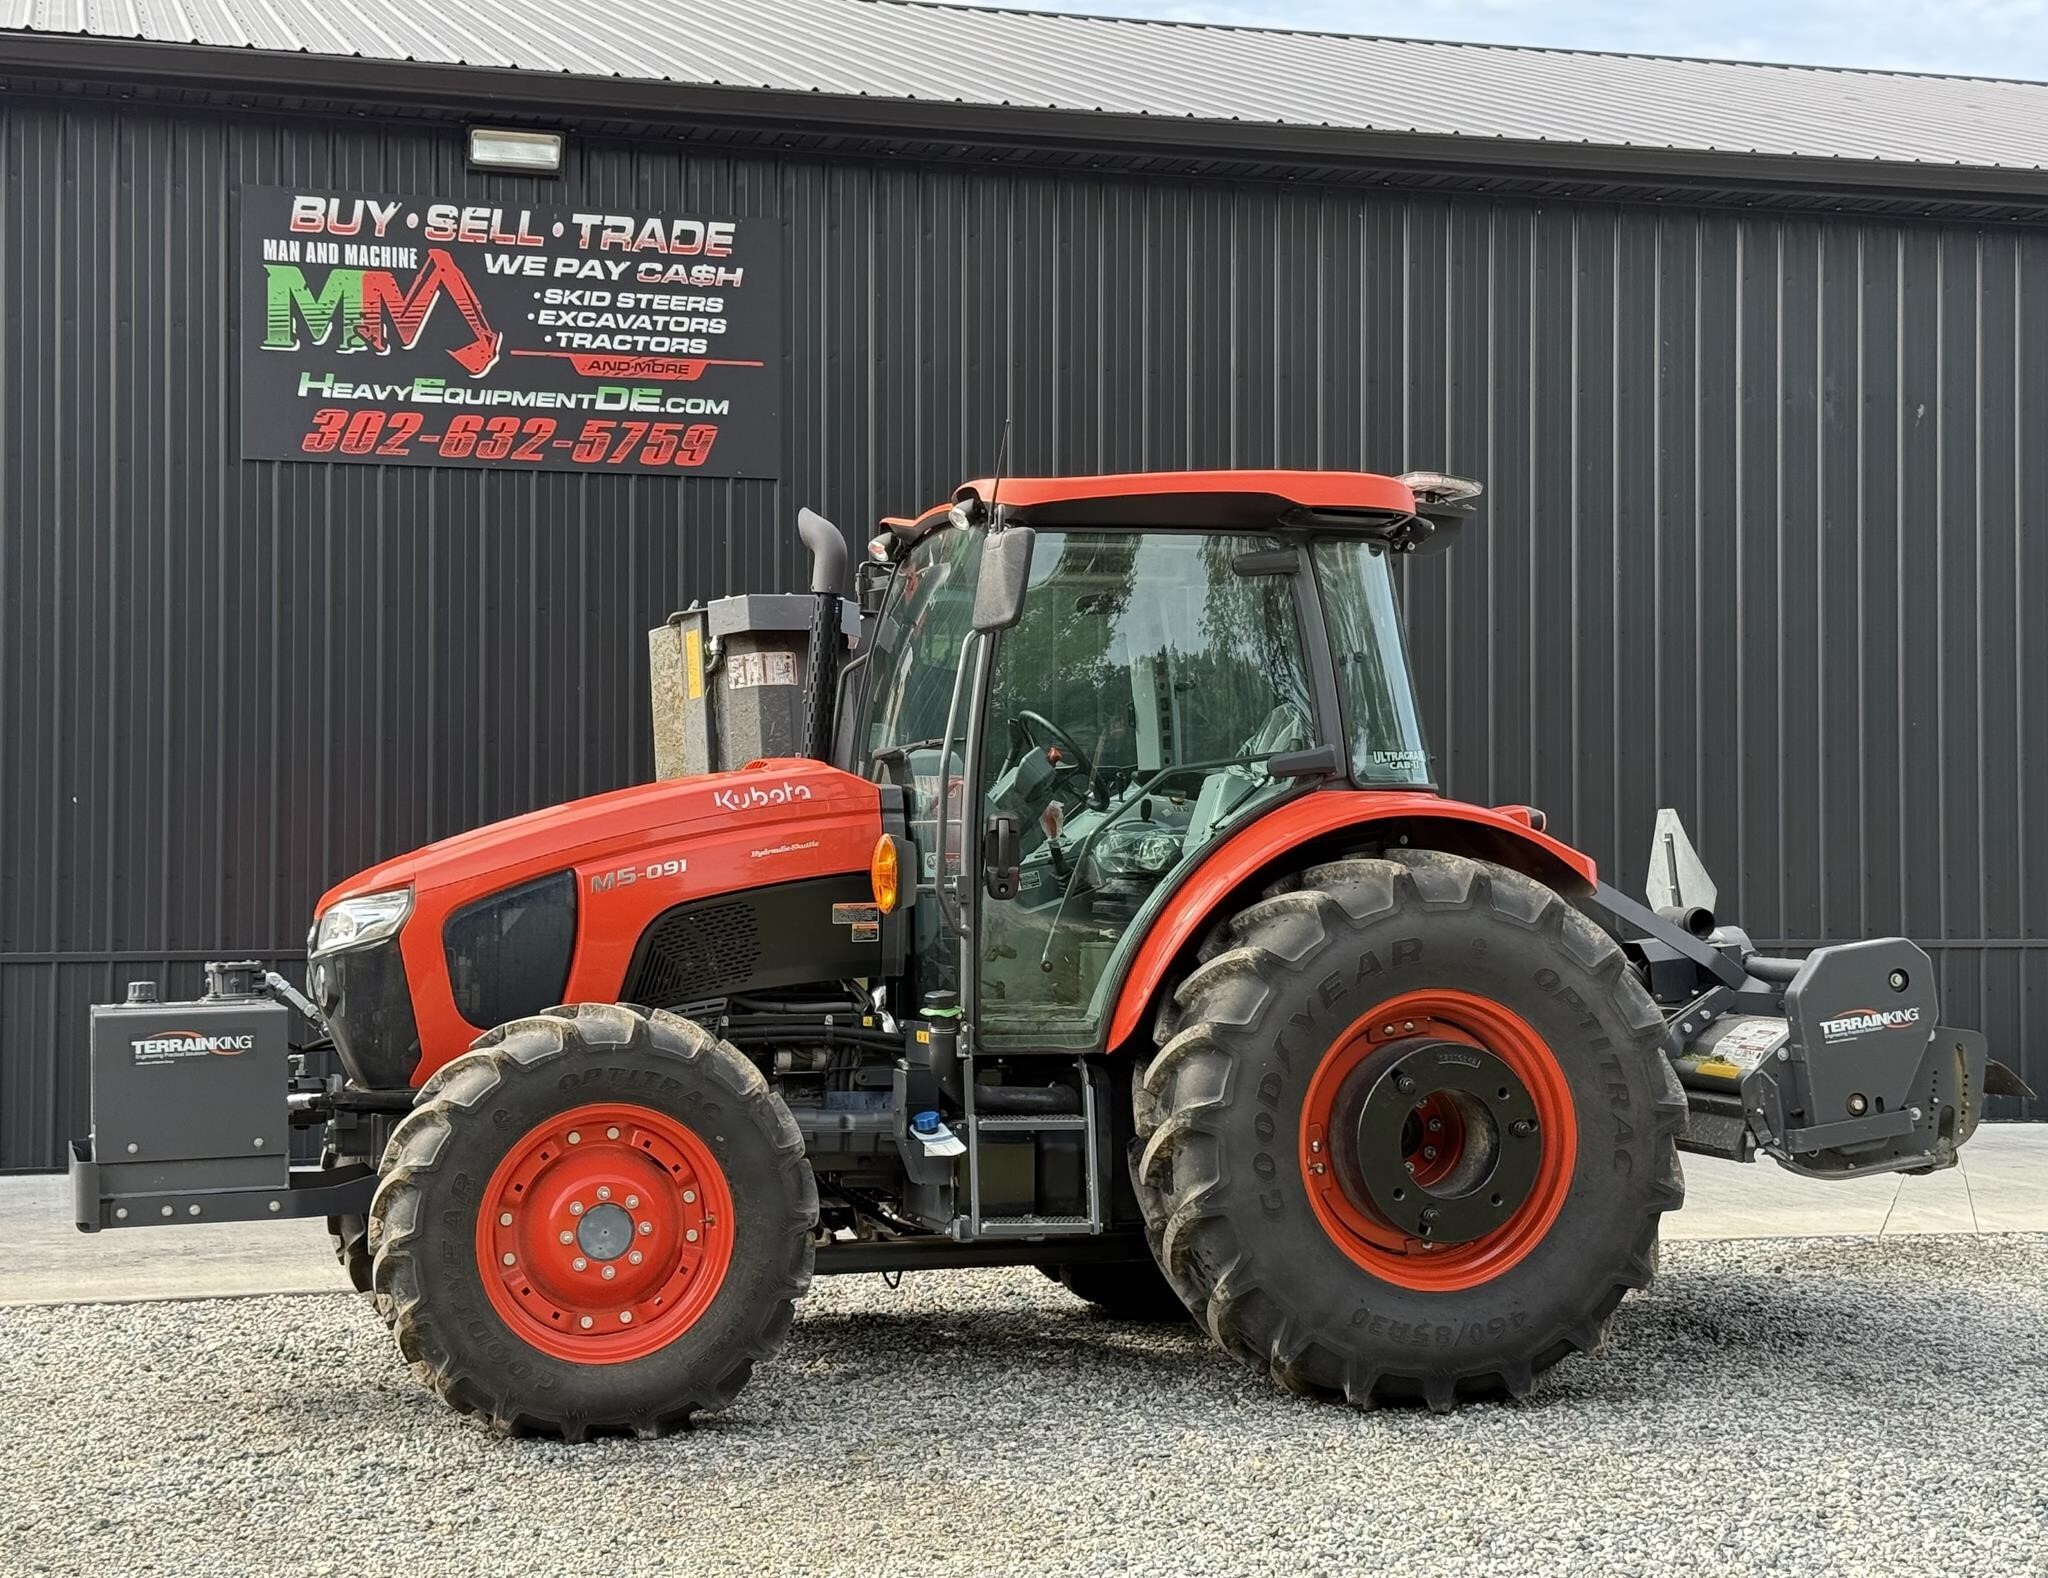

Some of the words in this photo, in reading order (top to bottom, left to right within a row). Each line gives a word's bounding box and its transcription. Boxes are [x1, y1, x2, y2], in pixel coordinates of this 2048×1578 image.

[289, 195, 402, 238] BUY
[425, 204, 545, 247] SELL
[571, 214, 736, 257] TRADE
[263, 240, 300, 263] MAN
[305, 243, 339, 266] AND
[344, 245, 418, 270] MACHINE
[484, 253, 548, 277] WE
[553, 257, 631, 281] PAY
[636, 262, 744, 288] CA$H
[543, 288, 612, 308] SKID
[616, 294, 725, 314] STEERS
[537, 309, 728, 335] EXCAVATORS
[555, 331, 708, 355] TRACTORS
[587, 360, 631, 373] AND
[633, 362, 691, 376] MORE
[301, 409, 718, 467] 302-632-5759
[714, 782, 811, 811] Kubota
[592, 859, 687, 894] M5-091
[1820, 1007, 1920, 1034] TERRAINKING
[131, 1035, 254, 1054] TERRAINKING
[1253, 936, 1424, 1223] GOODYEAR
[1535, 967, 1638, 1177] OPTITRAC
